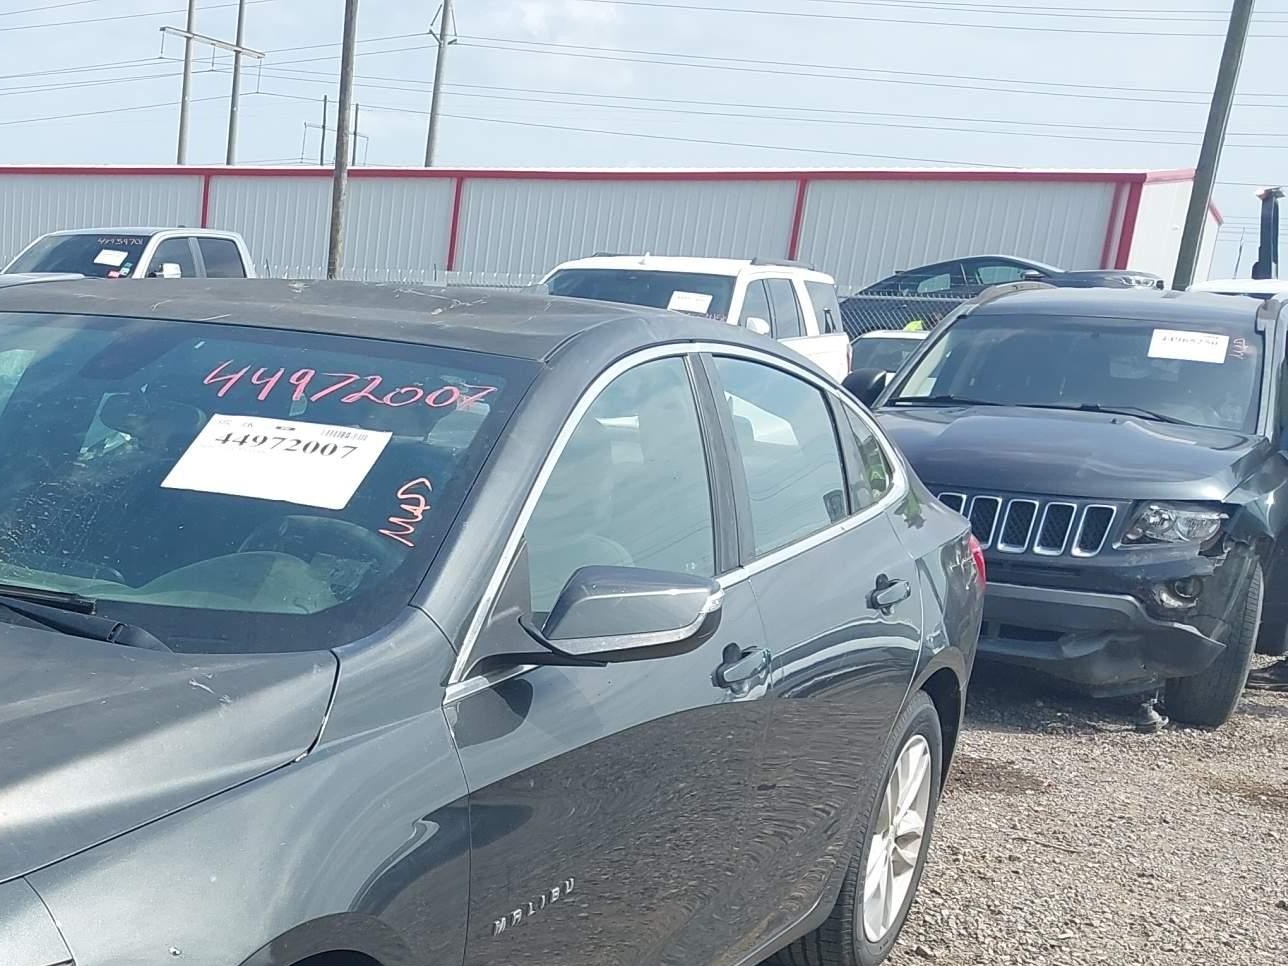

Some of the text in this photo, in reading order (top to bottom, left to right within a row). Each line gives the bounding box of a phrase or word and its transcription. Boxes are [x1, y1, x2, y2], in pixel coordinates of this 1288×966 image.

[203, 359, 499, 408] 44972007
[215, 432, 359, 459] 44972007
[493, 877, 575, 936] MALIBU
